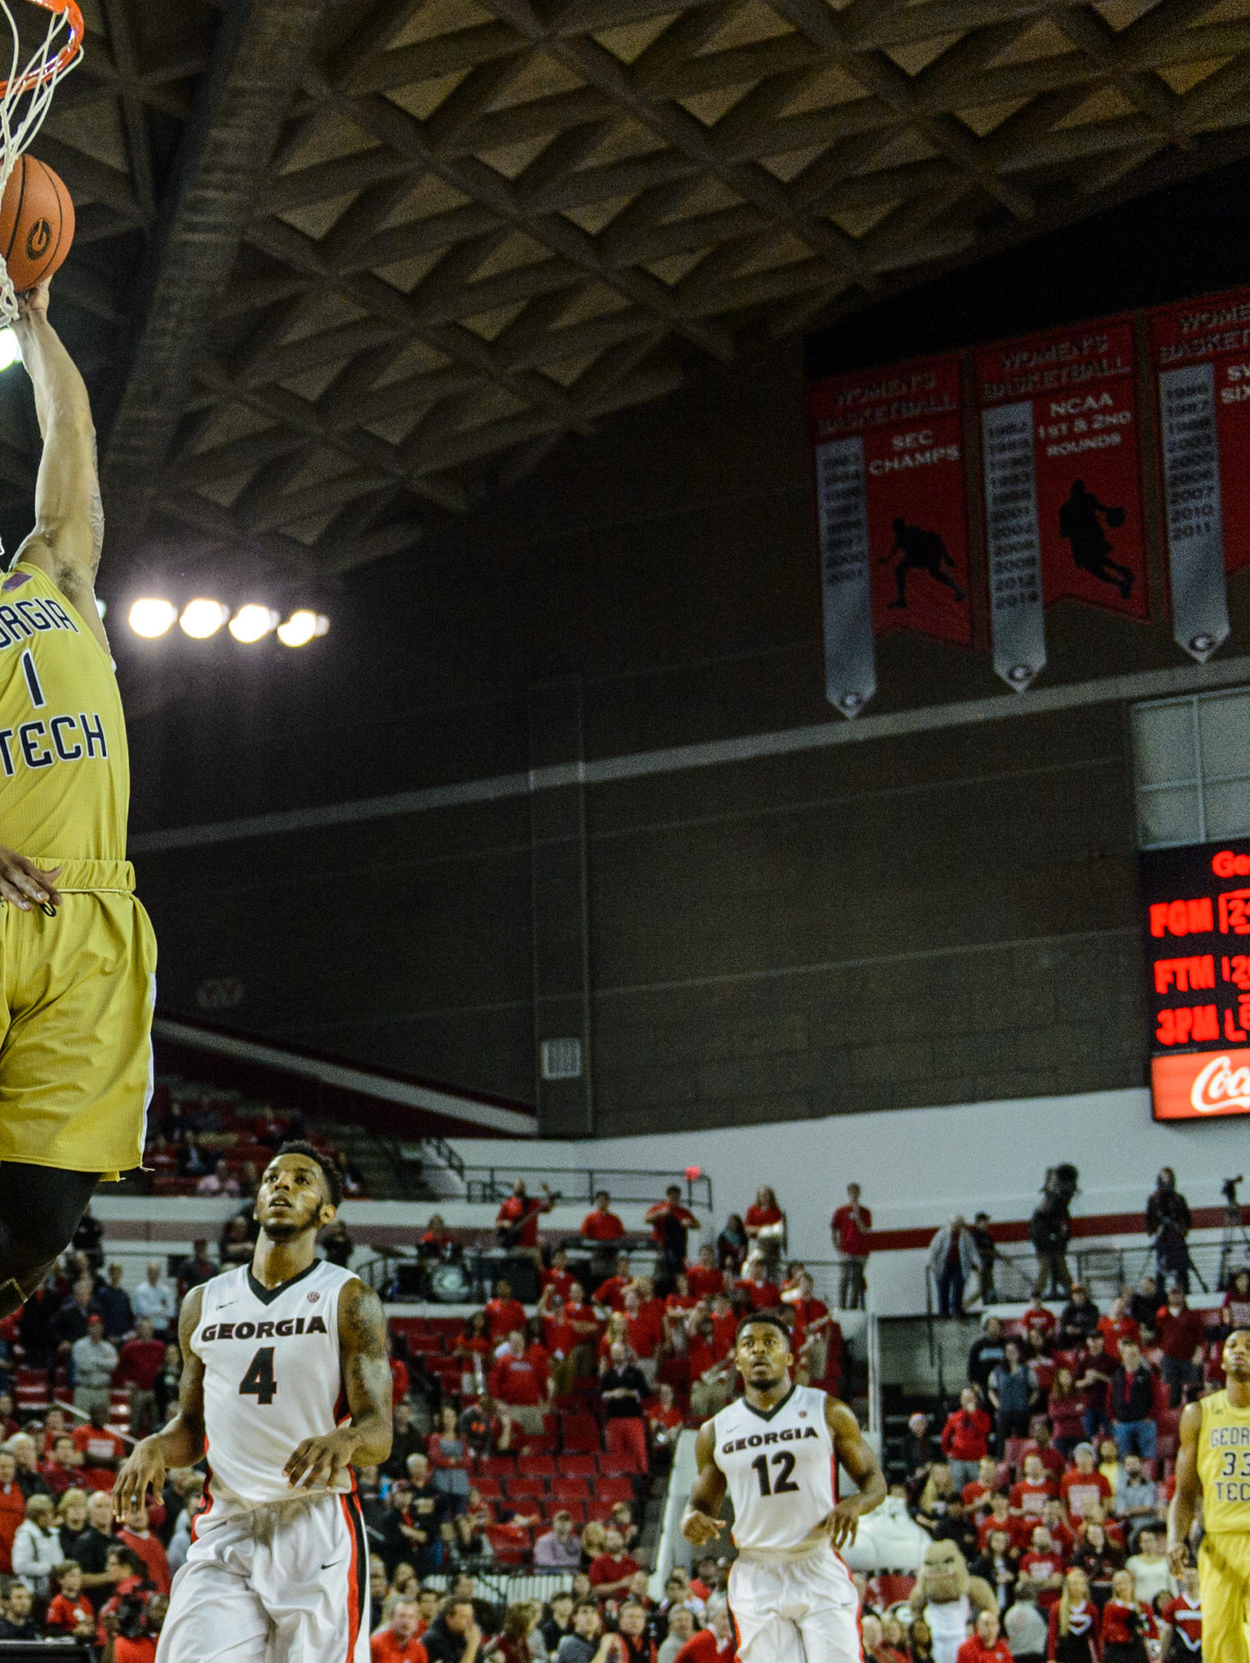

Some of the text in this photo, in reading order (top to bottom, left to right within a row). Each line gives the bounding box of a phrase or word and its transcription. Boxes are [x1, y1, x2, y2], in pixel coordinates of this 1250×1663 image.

[1049, 392, 1114, 417] NCAA
[891, 429, 935, 452] SEC
[1038, 422, 1070, 441] 1ST
[1092, 410, 1133, 430] 2ND
[1046, 431, 1123, 458] ROUNDS
[868, 444, 961, 476] CHAMPS
[1172, 503, 1213, 523] 2010
[1173, 521, 1211, 541] 2011
[21, 648, 46, 709] 1
[1154, 954, 1250, 994] FTM 2
[1156, 1004, 1220, 1046] 3PM
[201, 1316, 327, 1342] GEORGIA
[238, 1346, 278, 1405] 4
[722, 1426, 819, 1455] GEORGIA
[751, 1450, 800, 1497] 12
